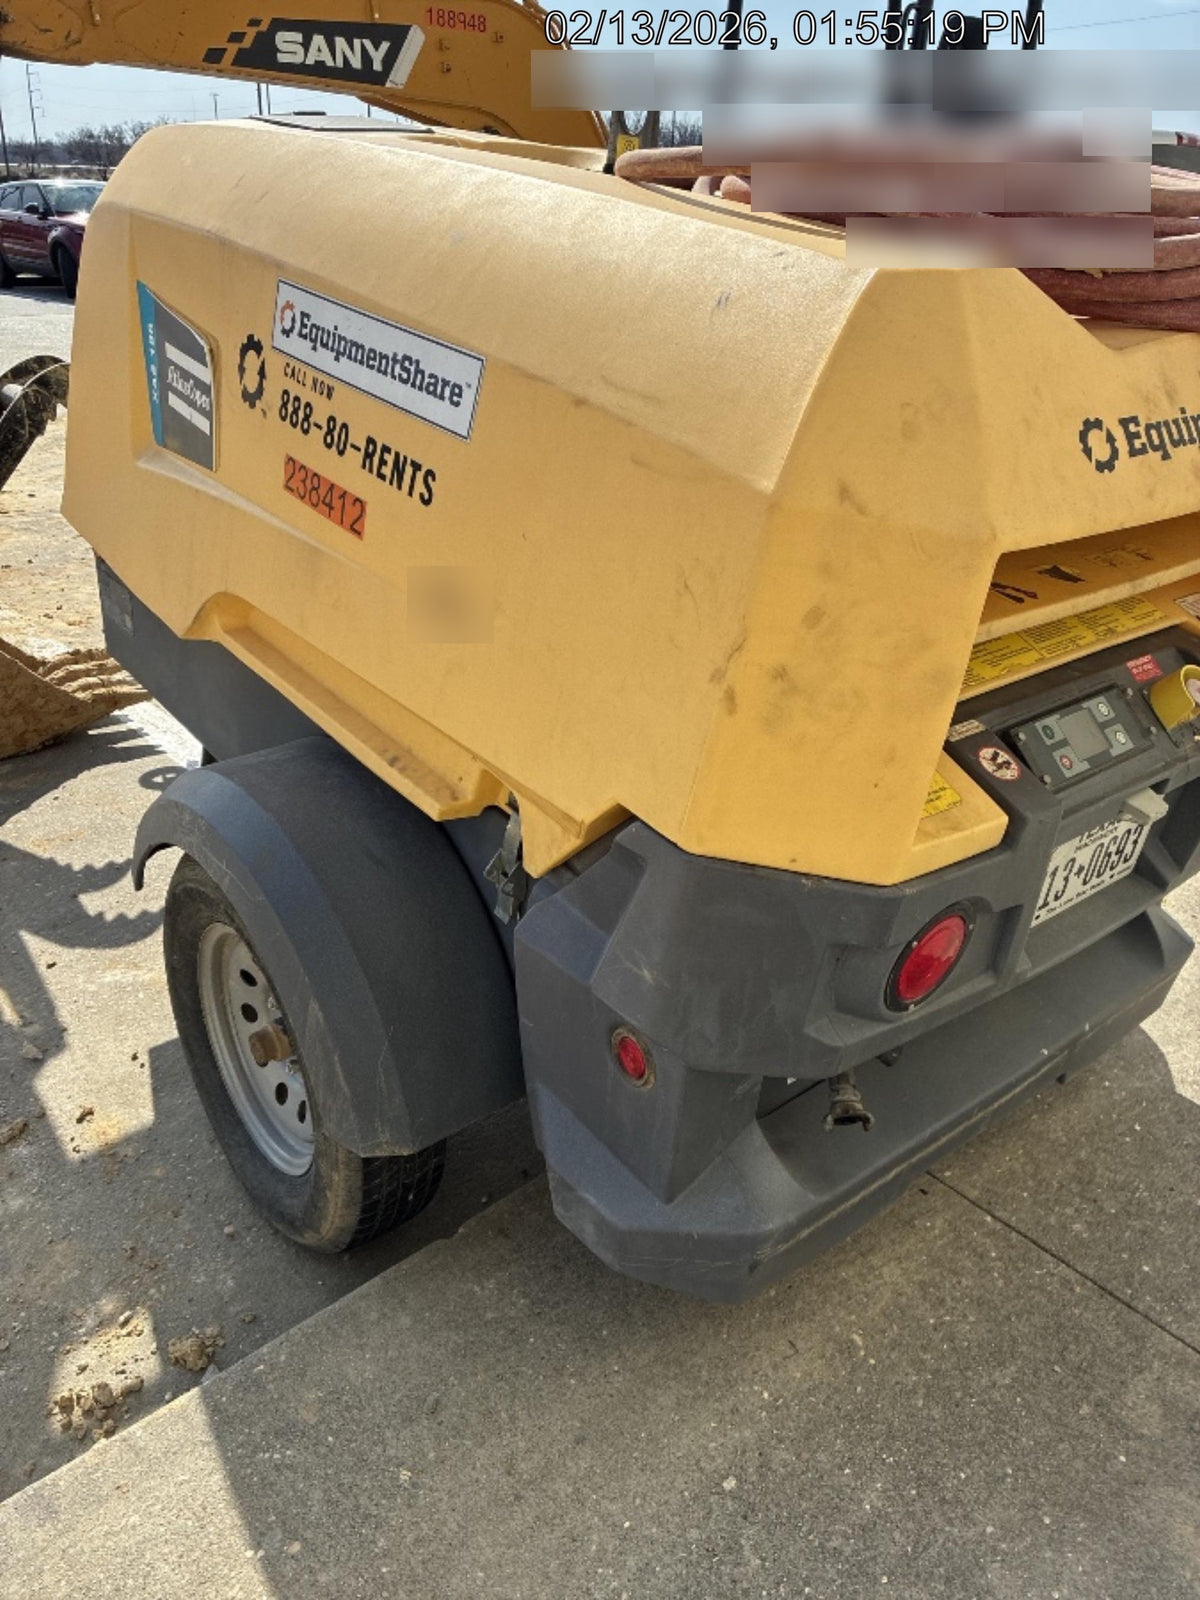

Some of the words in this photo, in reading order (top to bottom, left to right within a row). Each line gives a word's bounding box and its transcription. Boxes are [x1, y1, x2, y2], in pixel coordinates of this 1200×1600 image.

[425, 7, 487, 33] 188948
[275, 31, 391, 72] SANY
[284, 362, 307, 387] CALL
[311, 376, 335, 401] NOW
[297, 311, 464, 408] EquipmentShare
[278, 389, 437, 507] 888-80-RENTS
[284, 456, 366, 536] 238412
